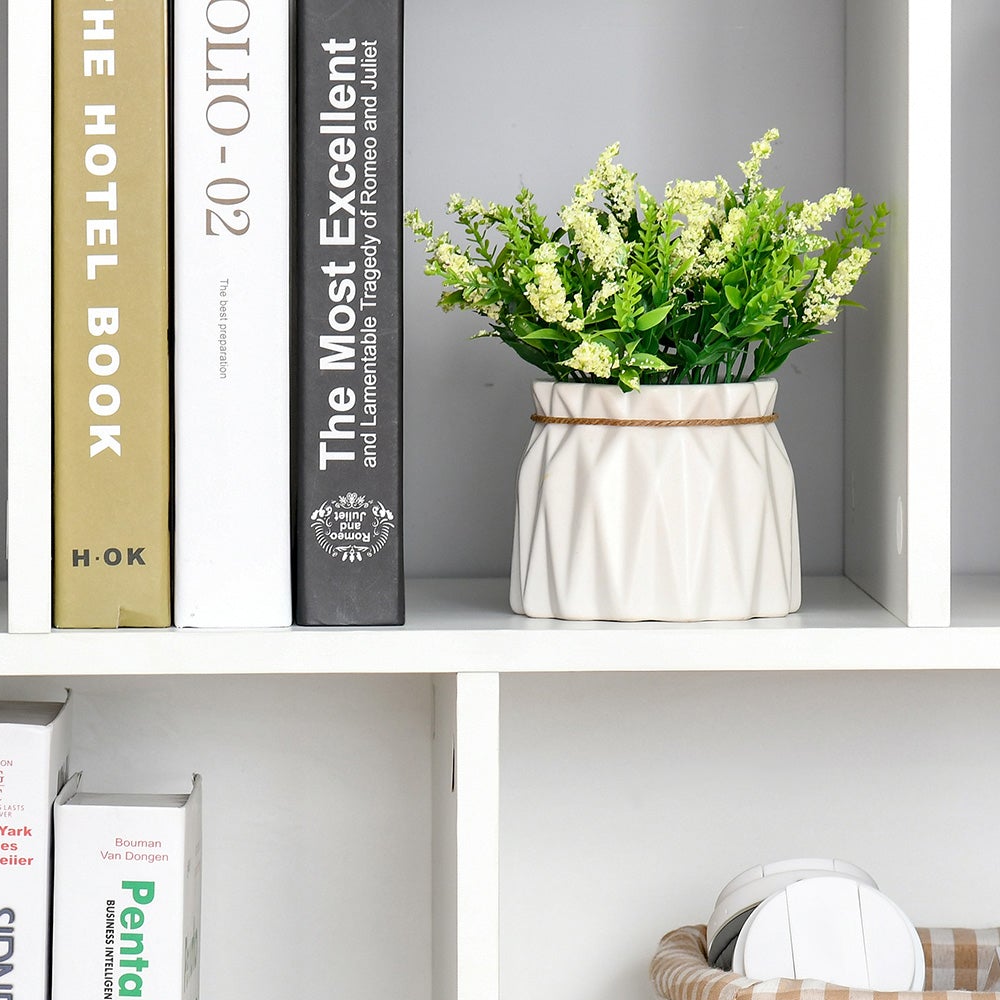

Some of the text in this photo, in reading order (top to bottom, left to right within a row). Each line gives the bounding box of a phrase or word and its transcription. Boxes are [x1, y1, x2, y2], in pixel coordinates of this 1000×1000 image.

[83, 0, 121, 458] HE HOTEL BOOK
[205, 177, 250, 236] 02
[319, 38, 356, 470] The Most Excellent
[360, 40, 381, 468] and Lamentable Tragedy of Romeo and Juliet
[218, 278, 229, 379] The best preparation
[328, 531, 370, 542] Romeo
[334, 511, 367, 522] Juliet
[340, 522, 361, 532] and
[100, 851, 169, 863] Van Dongen
[115, 838, 162, 848] Bouman
[105, 900, 115, 945] BUSINESS
